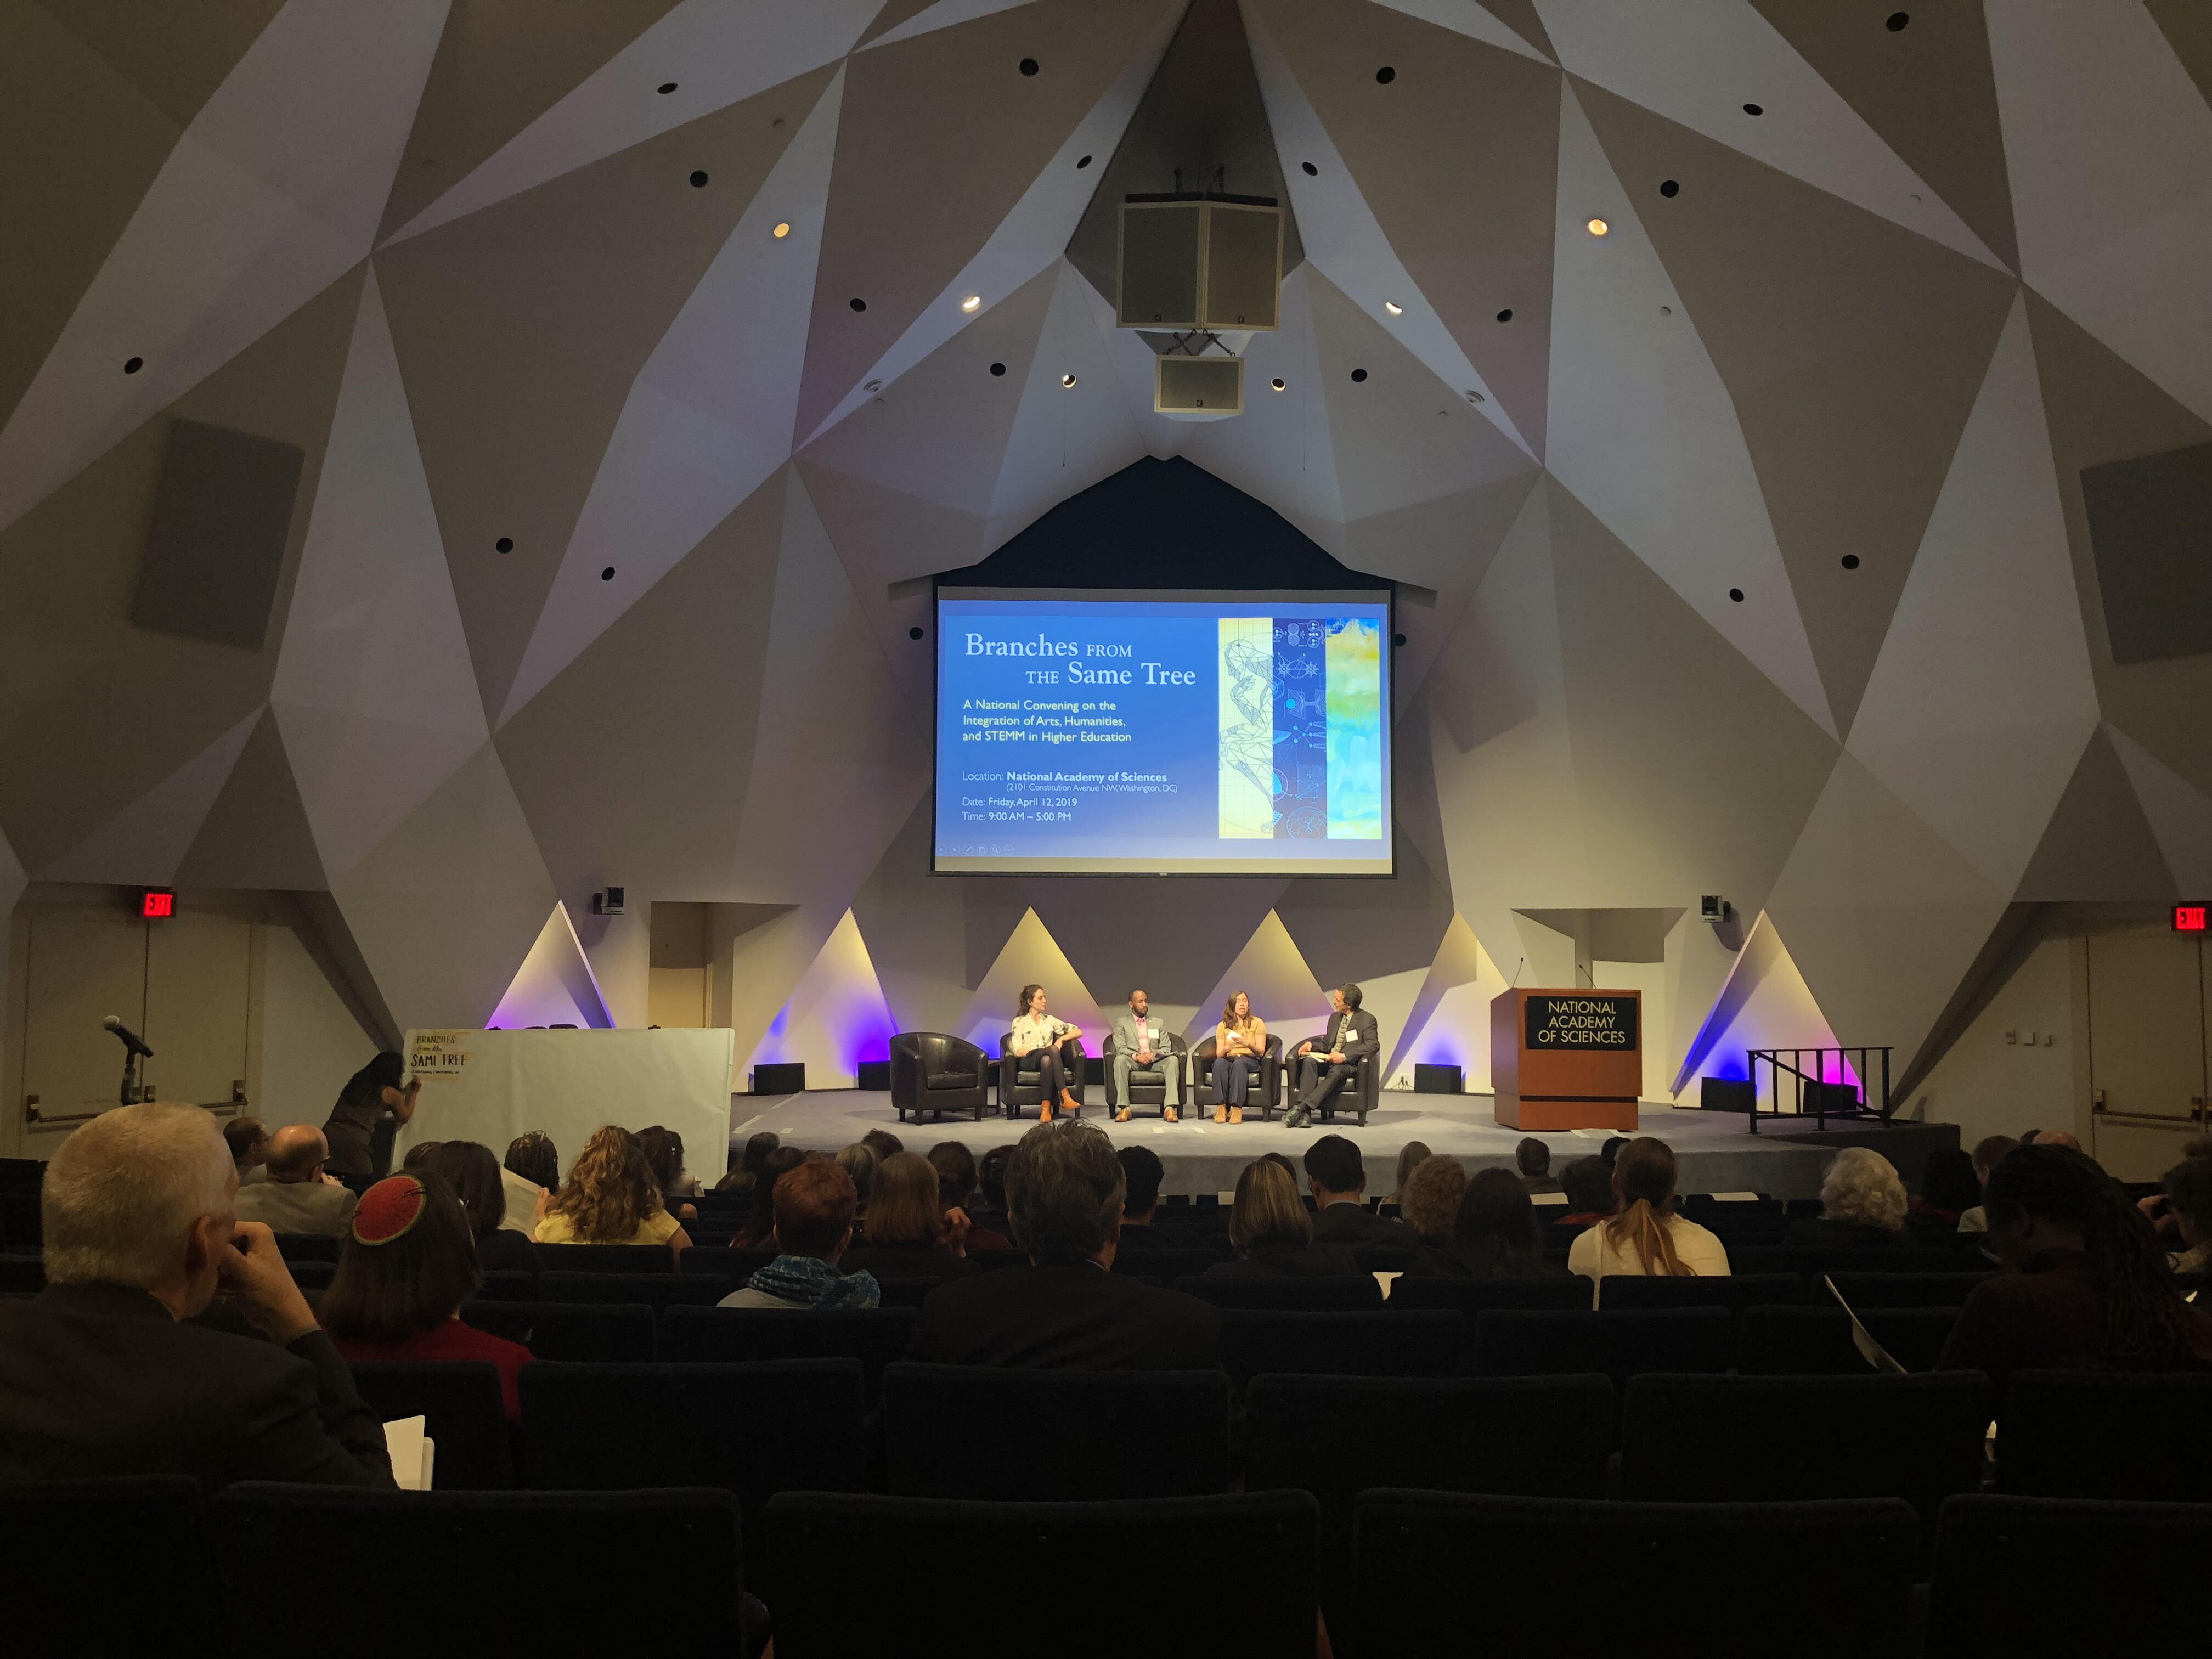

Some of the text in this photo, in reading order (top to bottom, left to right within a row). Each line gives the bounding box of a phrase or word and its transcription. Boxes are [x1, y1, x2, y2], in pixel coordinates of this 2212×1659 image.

[964, 633, 1132, 657] Branches FROM
[1025, 661, 1196, 685] THE Same Tree
[963, 699, 973, 709] A
[975, 699, 1020, 710] National
[1023, 699, 1079, 714] Convening
[1099, 700, 1116, 711] the
[963, 715, 1126, 729] Integration of Arts, Humanities,
[962, 730, 1132, 745] and STEMM in Higher Education
[963, 771, 1167, 784] Location: National Academy of Sciences
[1006, 783, 1026, 793] (2101
[1029, 783, 1072, 792] Constitution
[1163, 784, 1178, 794] DC)
[962, 797, 985, 806] Date:
[1042, 797, 1054, 808] 12,
[1056, 798, 1077, 807] 2019
[962, 811, 985, 821] Time:
[989, 811, 1008, 821] 9:00
[1008, 811, 1025, 821] AM
[1035, 812, 1055, 821] 5:00
[1057, 812, 1071, 821] PM
[144, 893, 173, 916] EXIT
[2176, 907, 2205, 929] EXIT
[1549, 1001, 1617, 1014] NATIONAL
[1548, 1015, 1615, 1029] ACADEMY
[416, 1035, 456, 1043] BRANCHES
[1538, 1030, 1626, 1043] OF SCIENCES
